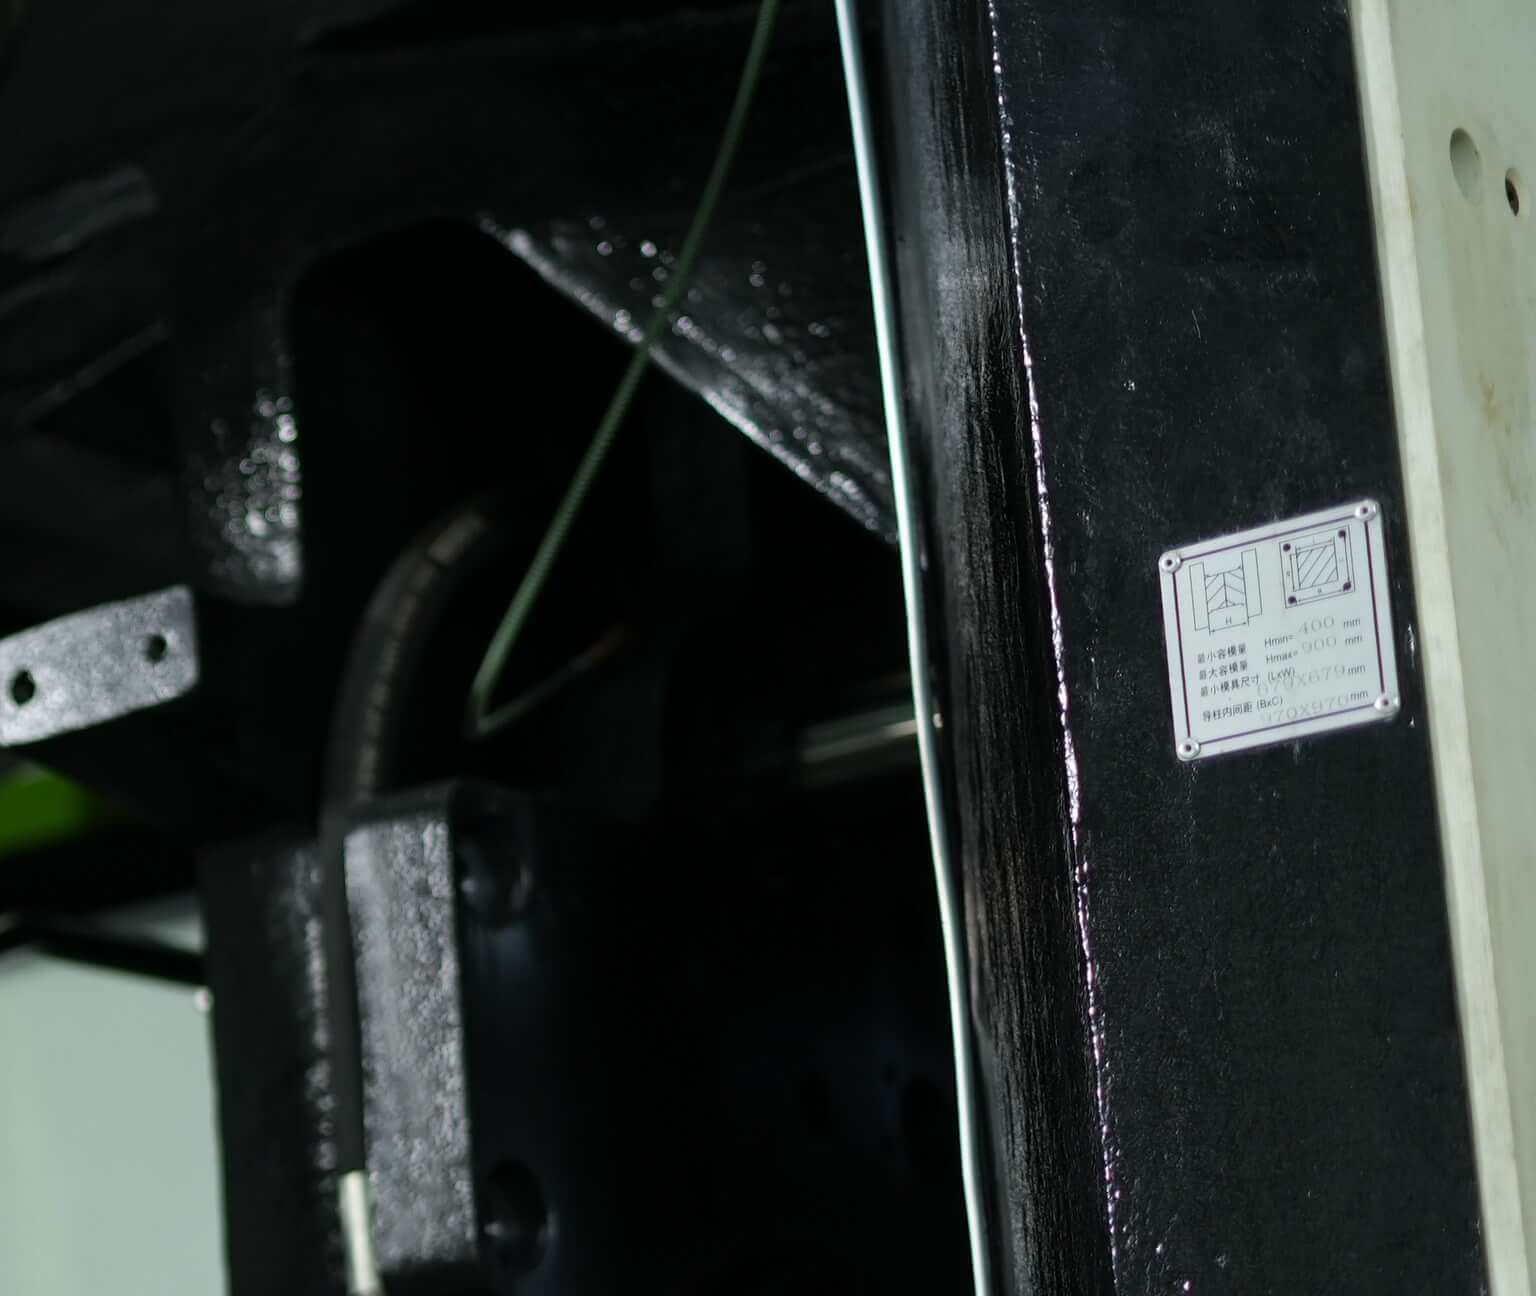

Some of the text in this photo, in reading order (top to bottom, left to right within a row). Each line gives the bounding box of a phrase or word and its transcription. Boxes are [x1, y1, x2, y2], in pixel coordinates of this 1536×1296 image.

[1343, 618, 1361, 630] mm
[1344, 634, 1363, 646] mm
[1347, 665, 1366, 676] mm
[1350, 691, 1369, 701] mm
